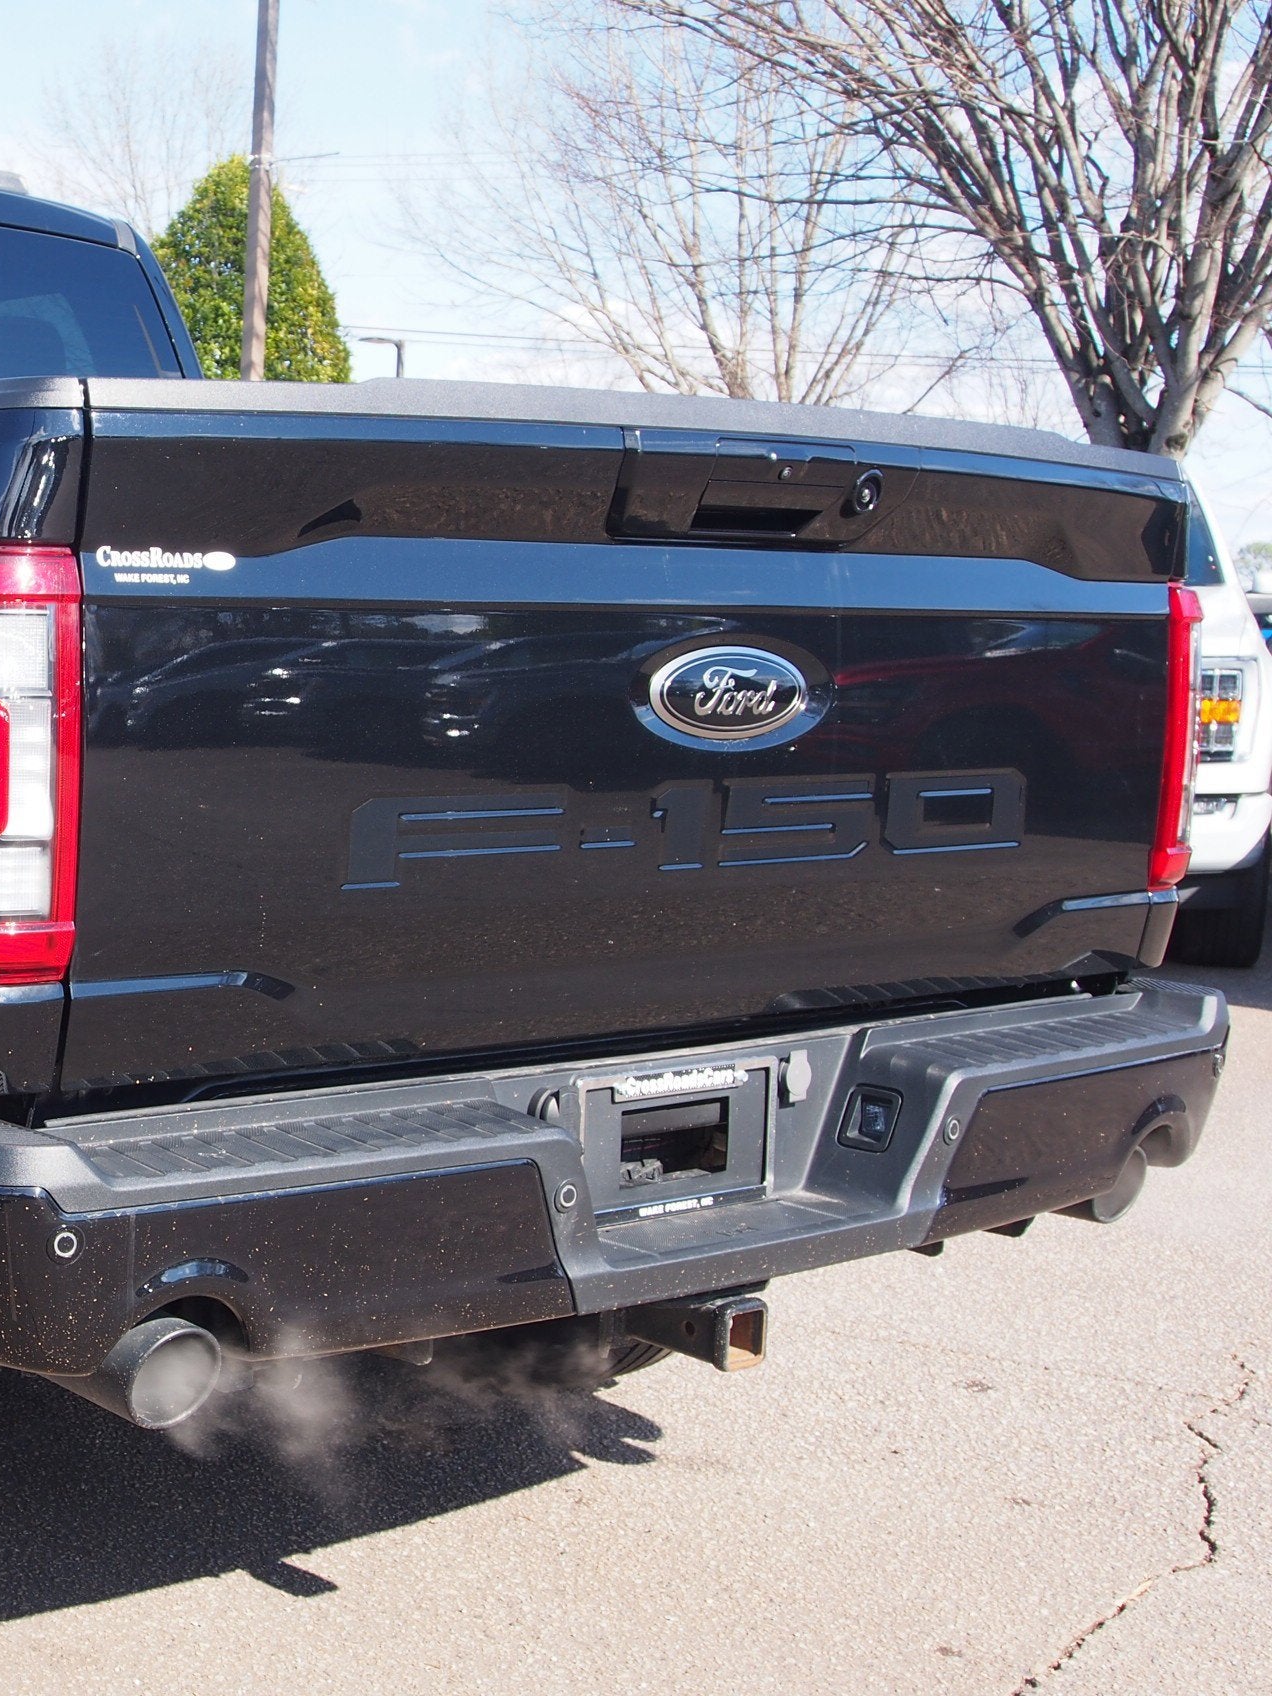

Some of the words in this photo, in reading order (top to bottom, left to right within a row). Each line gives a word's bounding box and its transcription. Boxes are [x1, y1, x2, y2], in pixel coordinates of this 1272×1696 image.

[114, 572, 140, 583] WAKE
[140, 573, 176, 585] FOREST,
[176, 574, 190, 584] NC
[694, 666, 777, 716] Ford
[340, 768, 1027, 890] F-150
